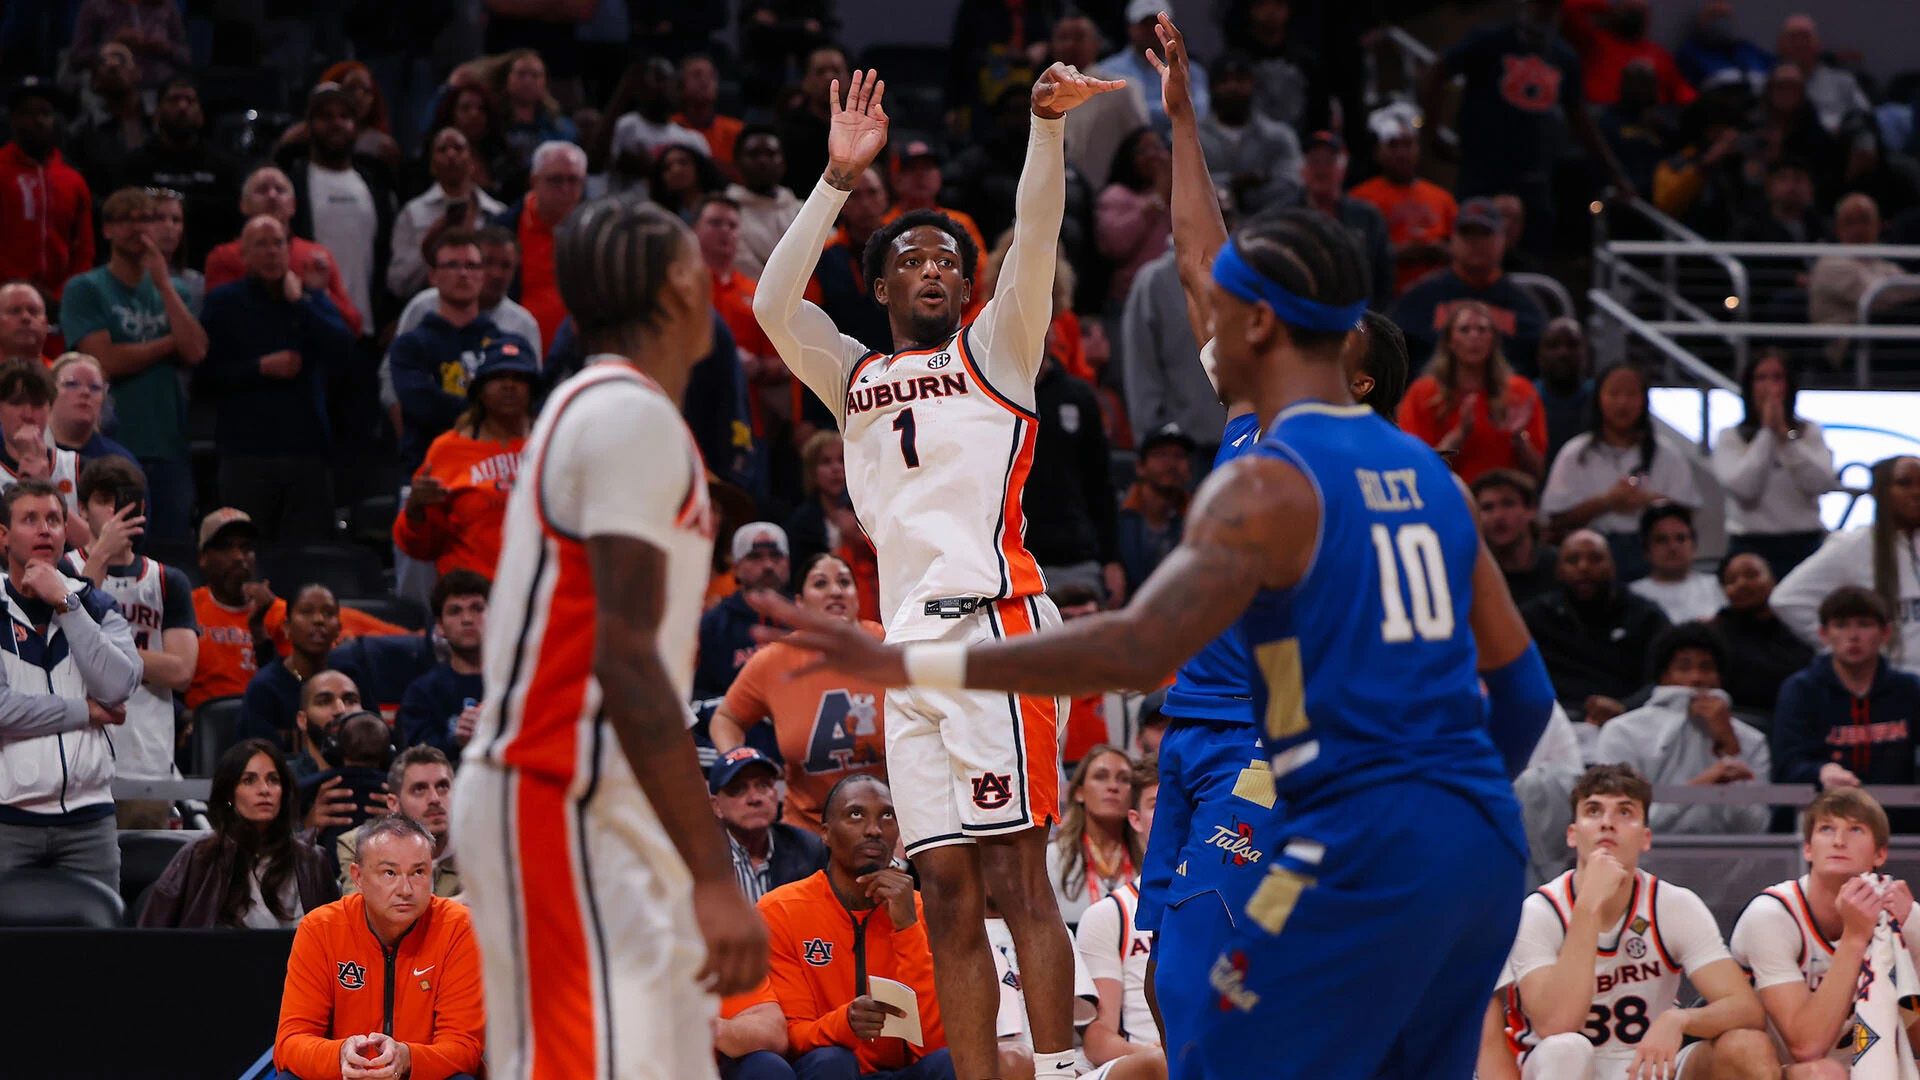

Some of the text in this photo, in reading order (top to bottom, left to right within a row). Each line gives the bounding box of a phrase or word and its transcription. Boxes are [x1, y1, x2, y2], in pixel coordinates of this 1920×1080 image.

[929, 353, 951, 369] SEC
[847, 372, 969, 416] AUBURN
[892, 407, 920, 469] 1
[1355, 468, 1425, 511] RILEY
[1371, 522, 1455, 643] 10
[1204, 825, 1263, 863] Tulsa
[1578, 995, 1651, 1047] 38
